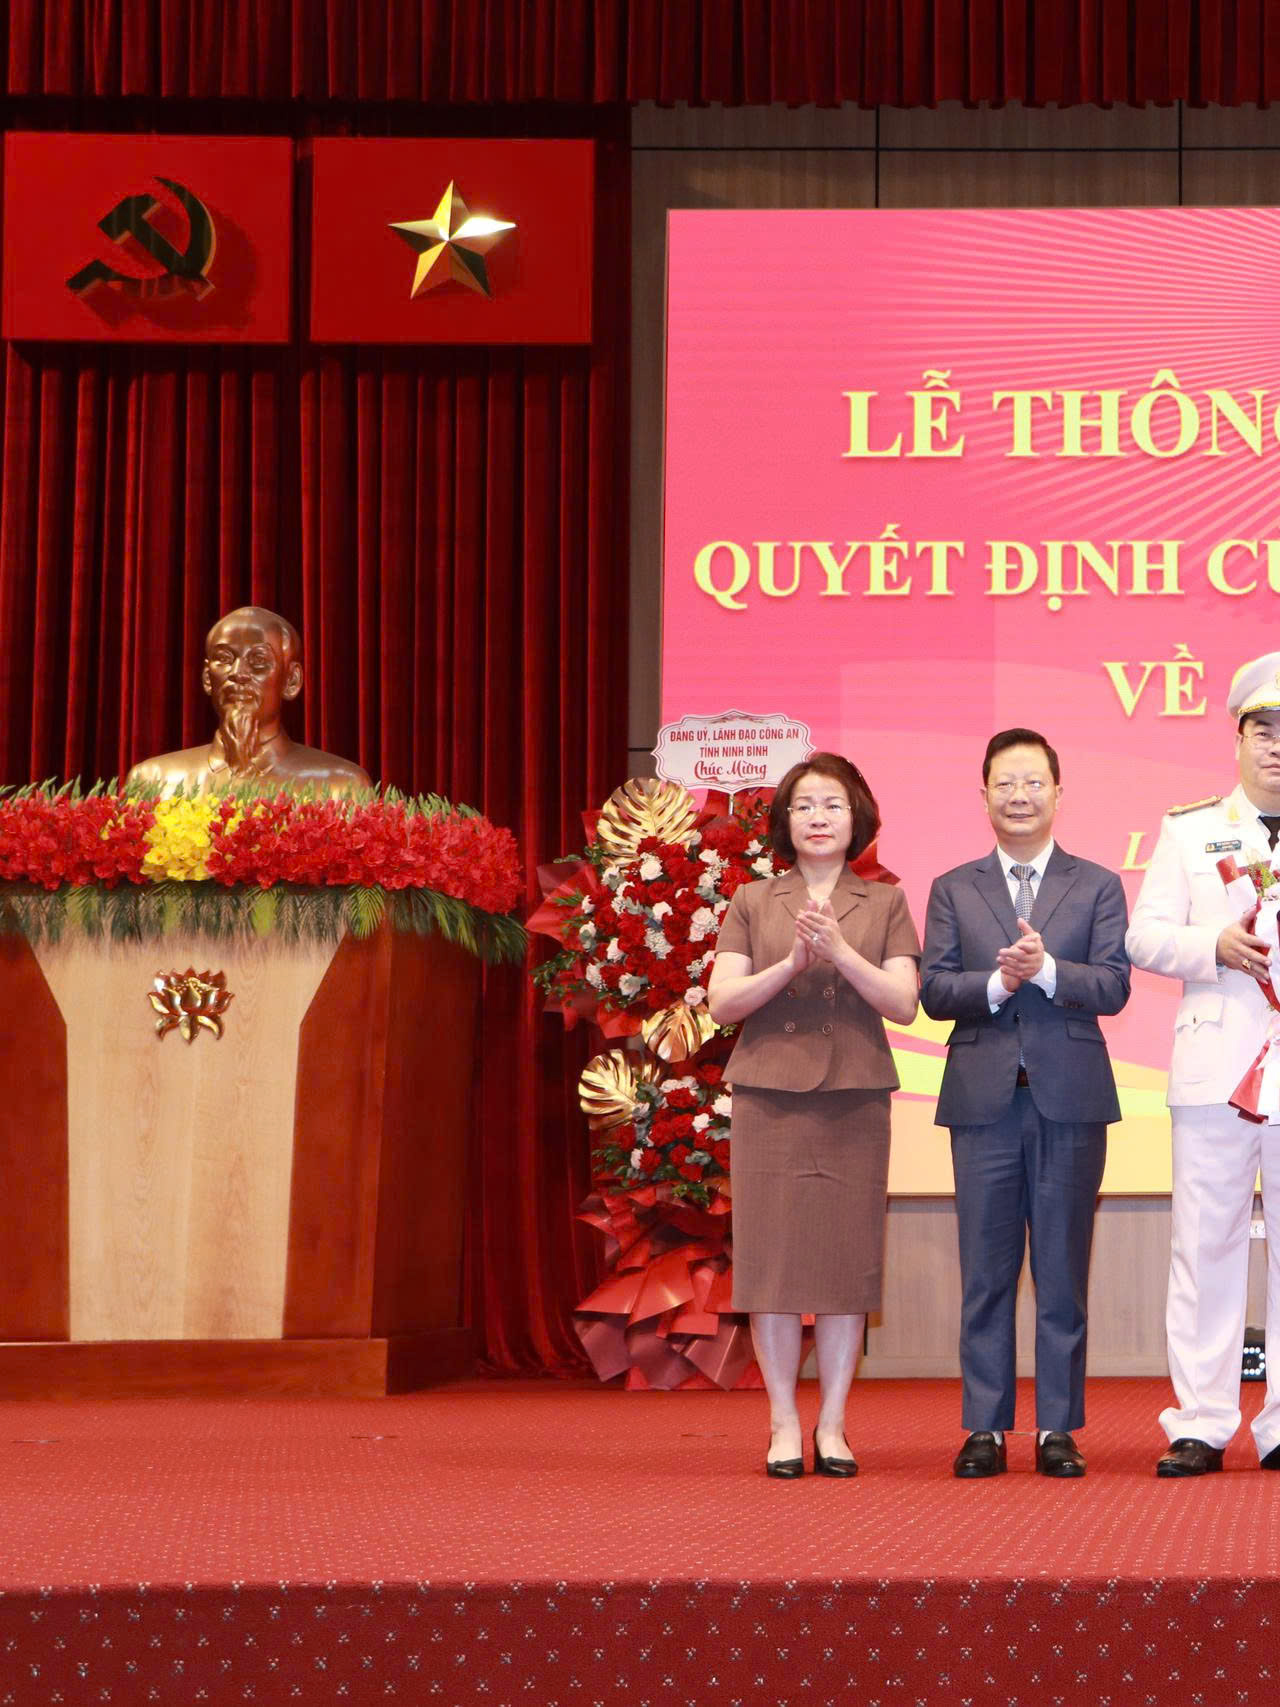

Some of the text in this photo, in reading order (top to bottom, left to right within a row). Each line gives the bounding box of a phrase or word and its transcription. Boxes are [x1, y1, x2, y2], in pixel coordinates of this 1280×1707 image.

[842, 369, 966, 459] LỄ
[693, 523, 966, 610] QUYẾT
[984, 539, 1185, 611] ĐỊNH
[1103, 643, 1208, 717] VỀ
[670, 727, 695, 742] ĐẢNG
[713, 727, 736, 741] LÃNH
[738, 729, 757, 743] ĐẠO
[759, 726, 784, 740] CÔNG
[786, 728, 799, 739] AN
[699, 743, 769, 758] TỈNH NINH BÌNH
[694, 760, 768, 781] Chúc Mừng
